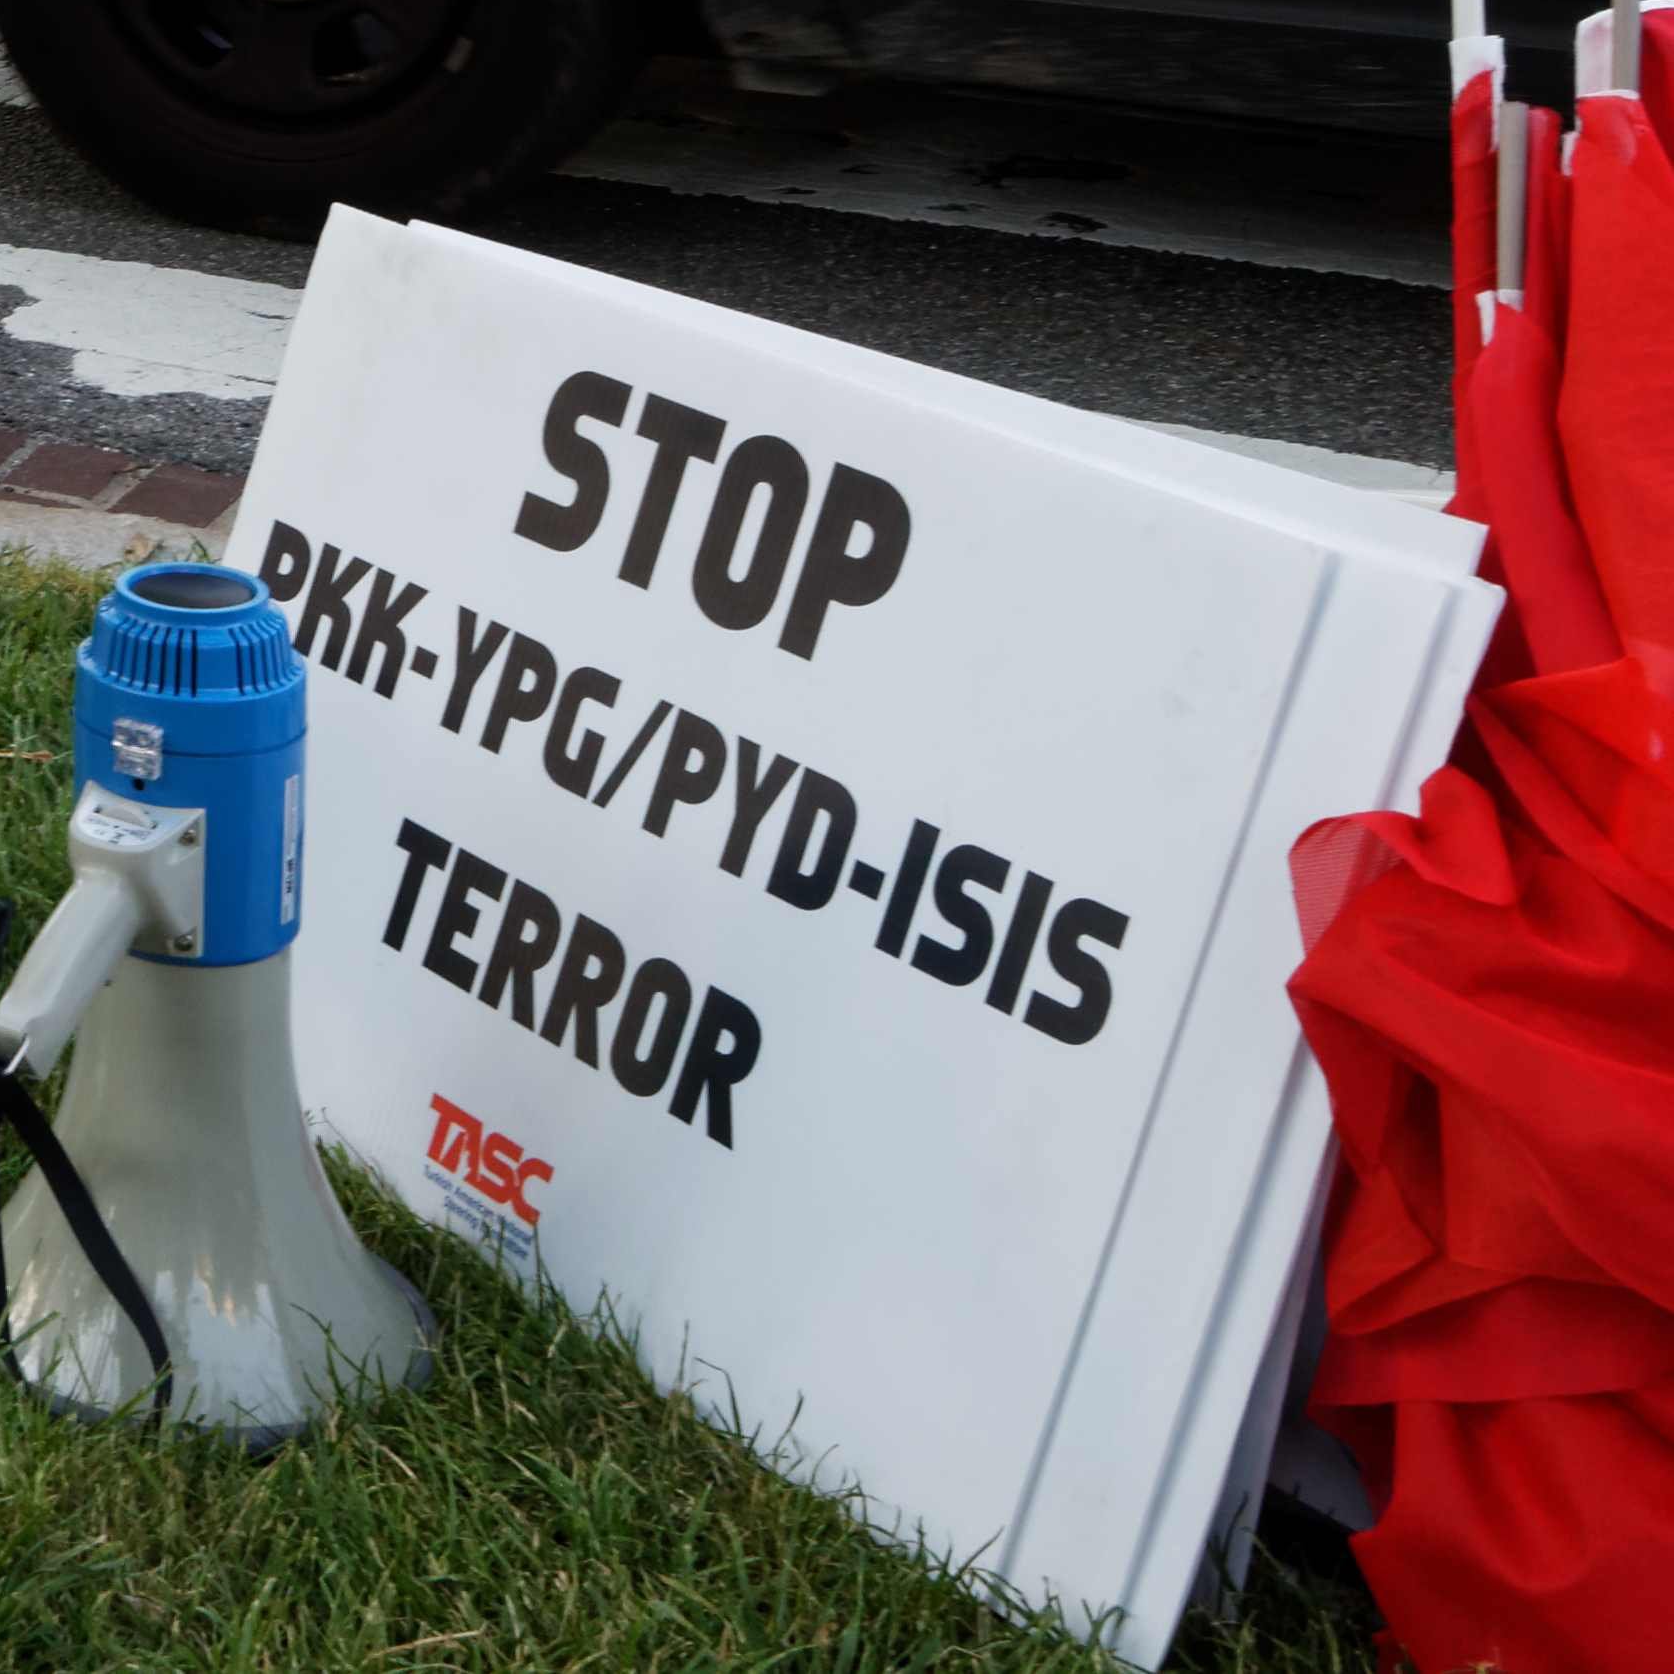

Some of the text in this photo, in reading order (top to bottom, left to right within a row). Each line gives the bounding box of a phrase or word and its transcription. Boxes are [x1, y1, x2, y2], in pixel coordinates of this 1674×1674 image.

[513, 369, 912, 662] STOP
[257, 519, 1130, 1047] PKK-YPG/PYD-ISIS
[382, 817, 762, 1151] TERROR
[427, 1093, 554, 1227] TASC
